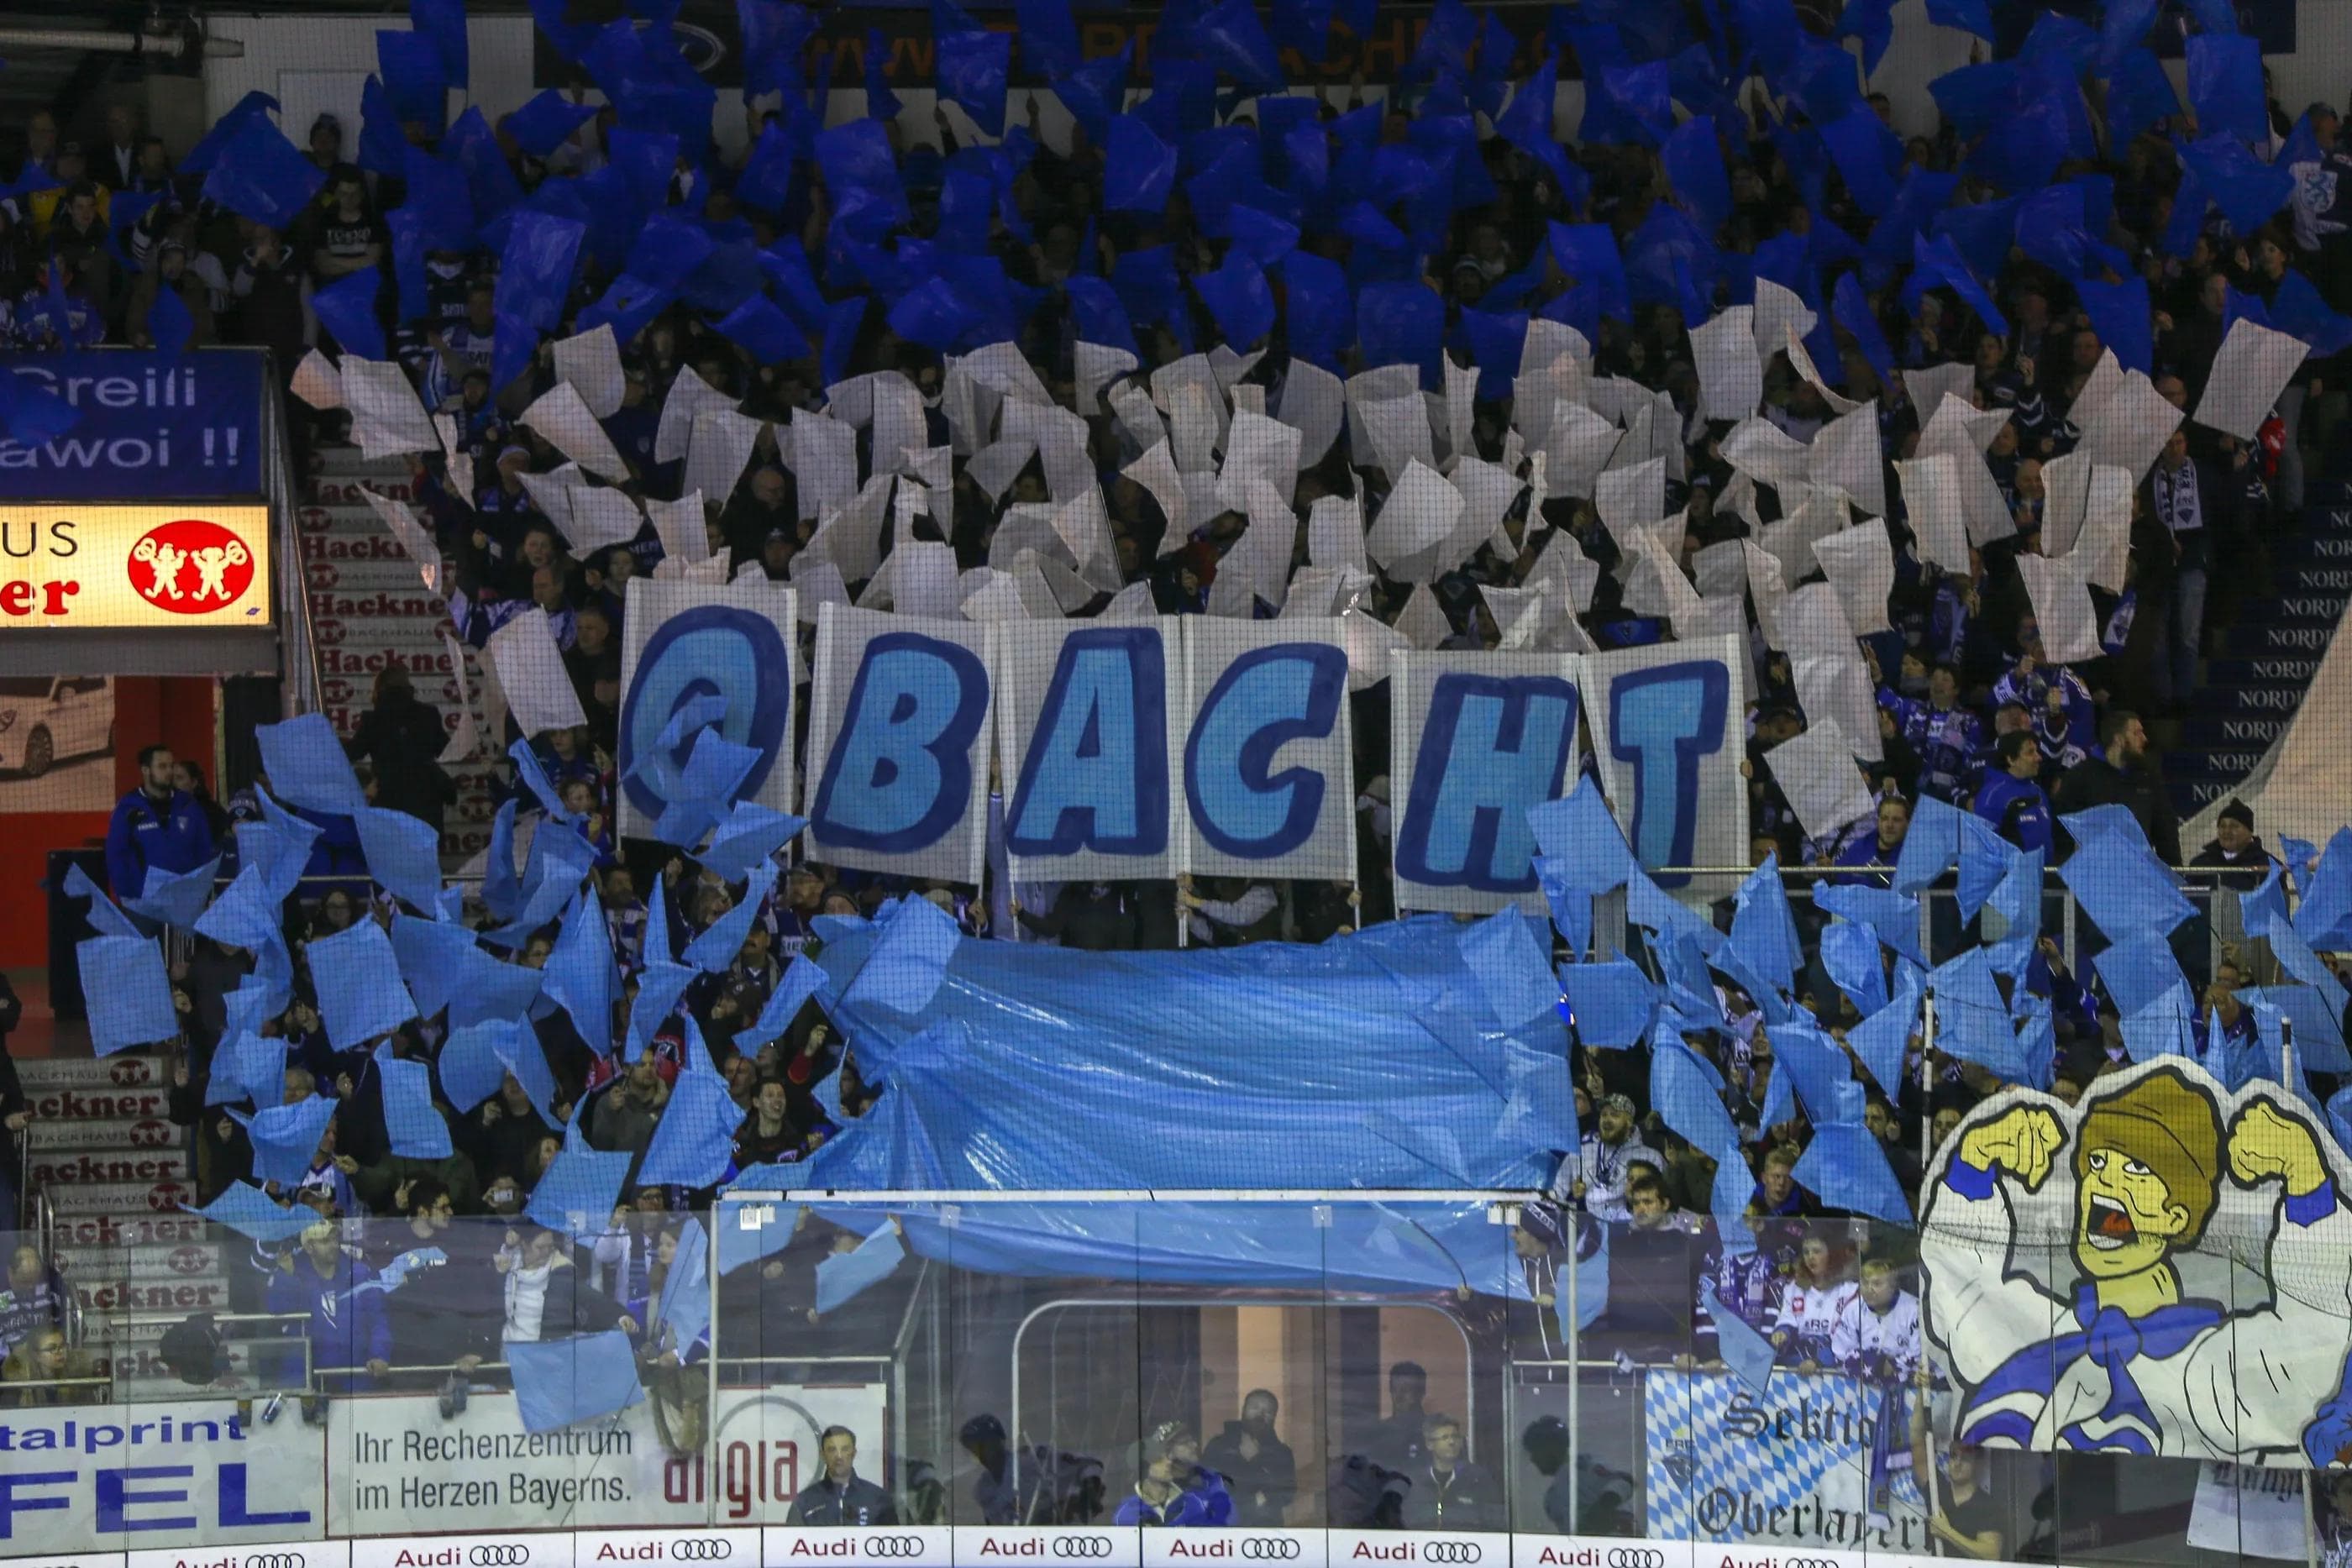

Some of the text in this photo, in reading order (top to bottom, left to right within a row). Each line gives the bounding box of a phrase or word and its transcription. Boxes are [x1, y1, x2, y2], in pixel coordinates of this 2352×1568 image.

[355, 1427, 633, 1463] Ihr Rechenzentrum
[355, 1472, 633, 1511] im Herzen Bayerns.
[395, 1547, 461, 1566] Audi
[596, 1541, 664, 1560] Audi
[790, 1538, 857, 1556] Audi
[979, 1538, 1045, 1556] Audi
[1168, 1539, 1234, 1557] Audi
[1352, 1541, 1416, 1560] Audi
[1538, 1546, 1600, 1565] Audi
